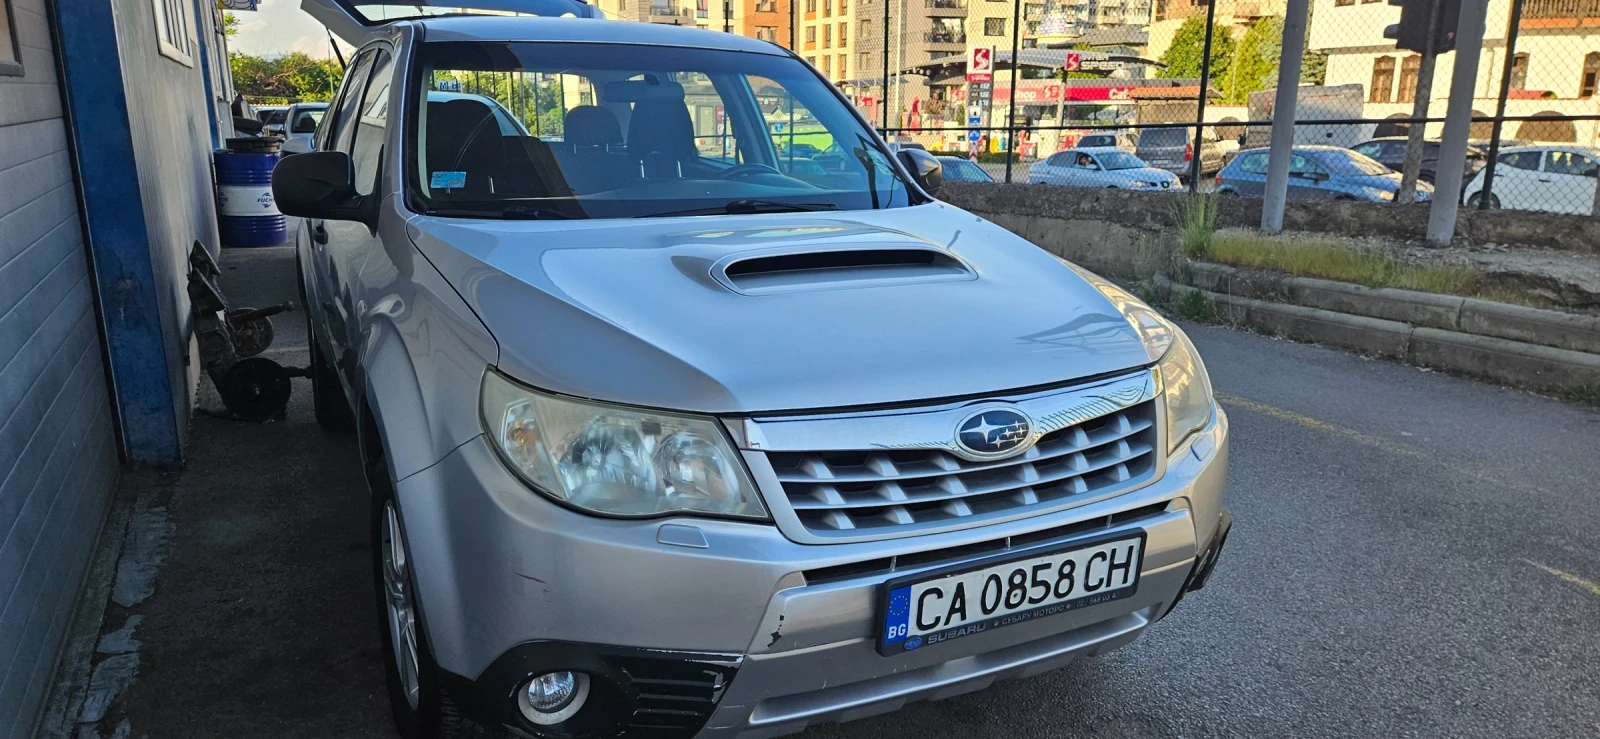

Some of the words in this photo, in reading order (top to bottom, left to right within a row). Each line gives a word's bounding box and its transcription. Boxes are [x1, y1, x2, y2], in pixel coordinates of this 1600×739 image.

[1015, 90, 1037, 101] hop
[1109, 89, 1130, 99] Caf
[915, 582, 967, 631] CA
[981, 559, 1076, 615] 0858
[1083, 545, 1134, 592] CH
[888, 624, 906, 639] BG
[927, 623, 987, 644] SUBARU
